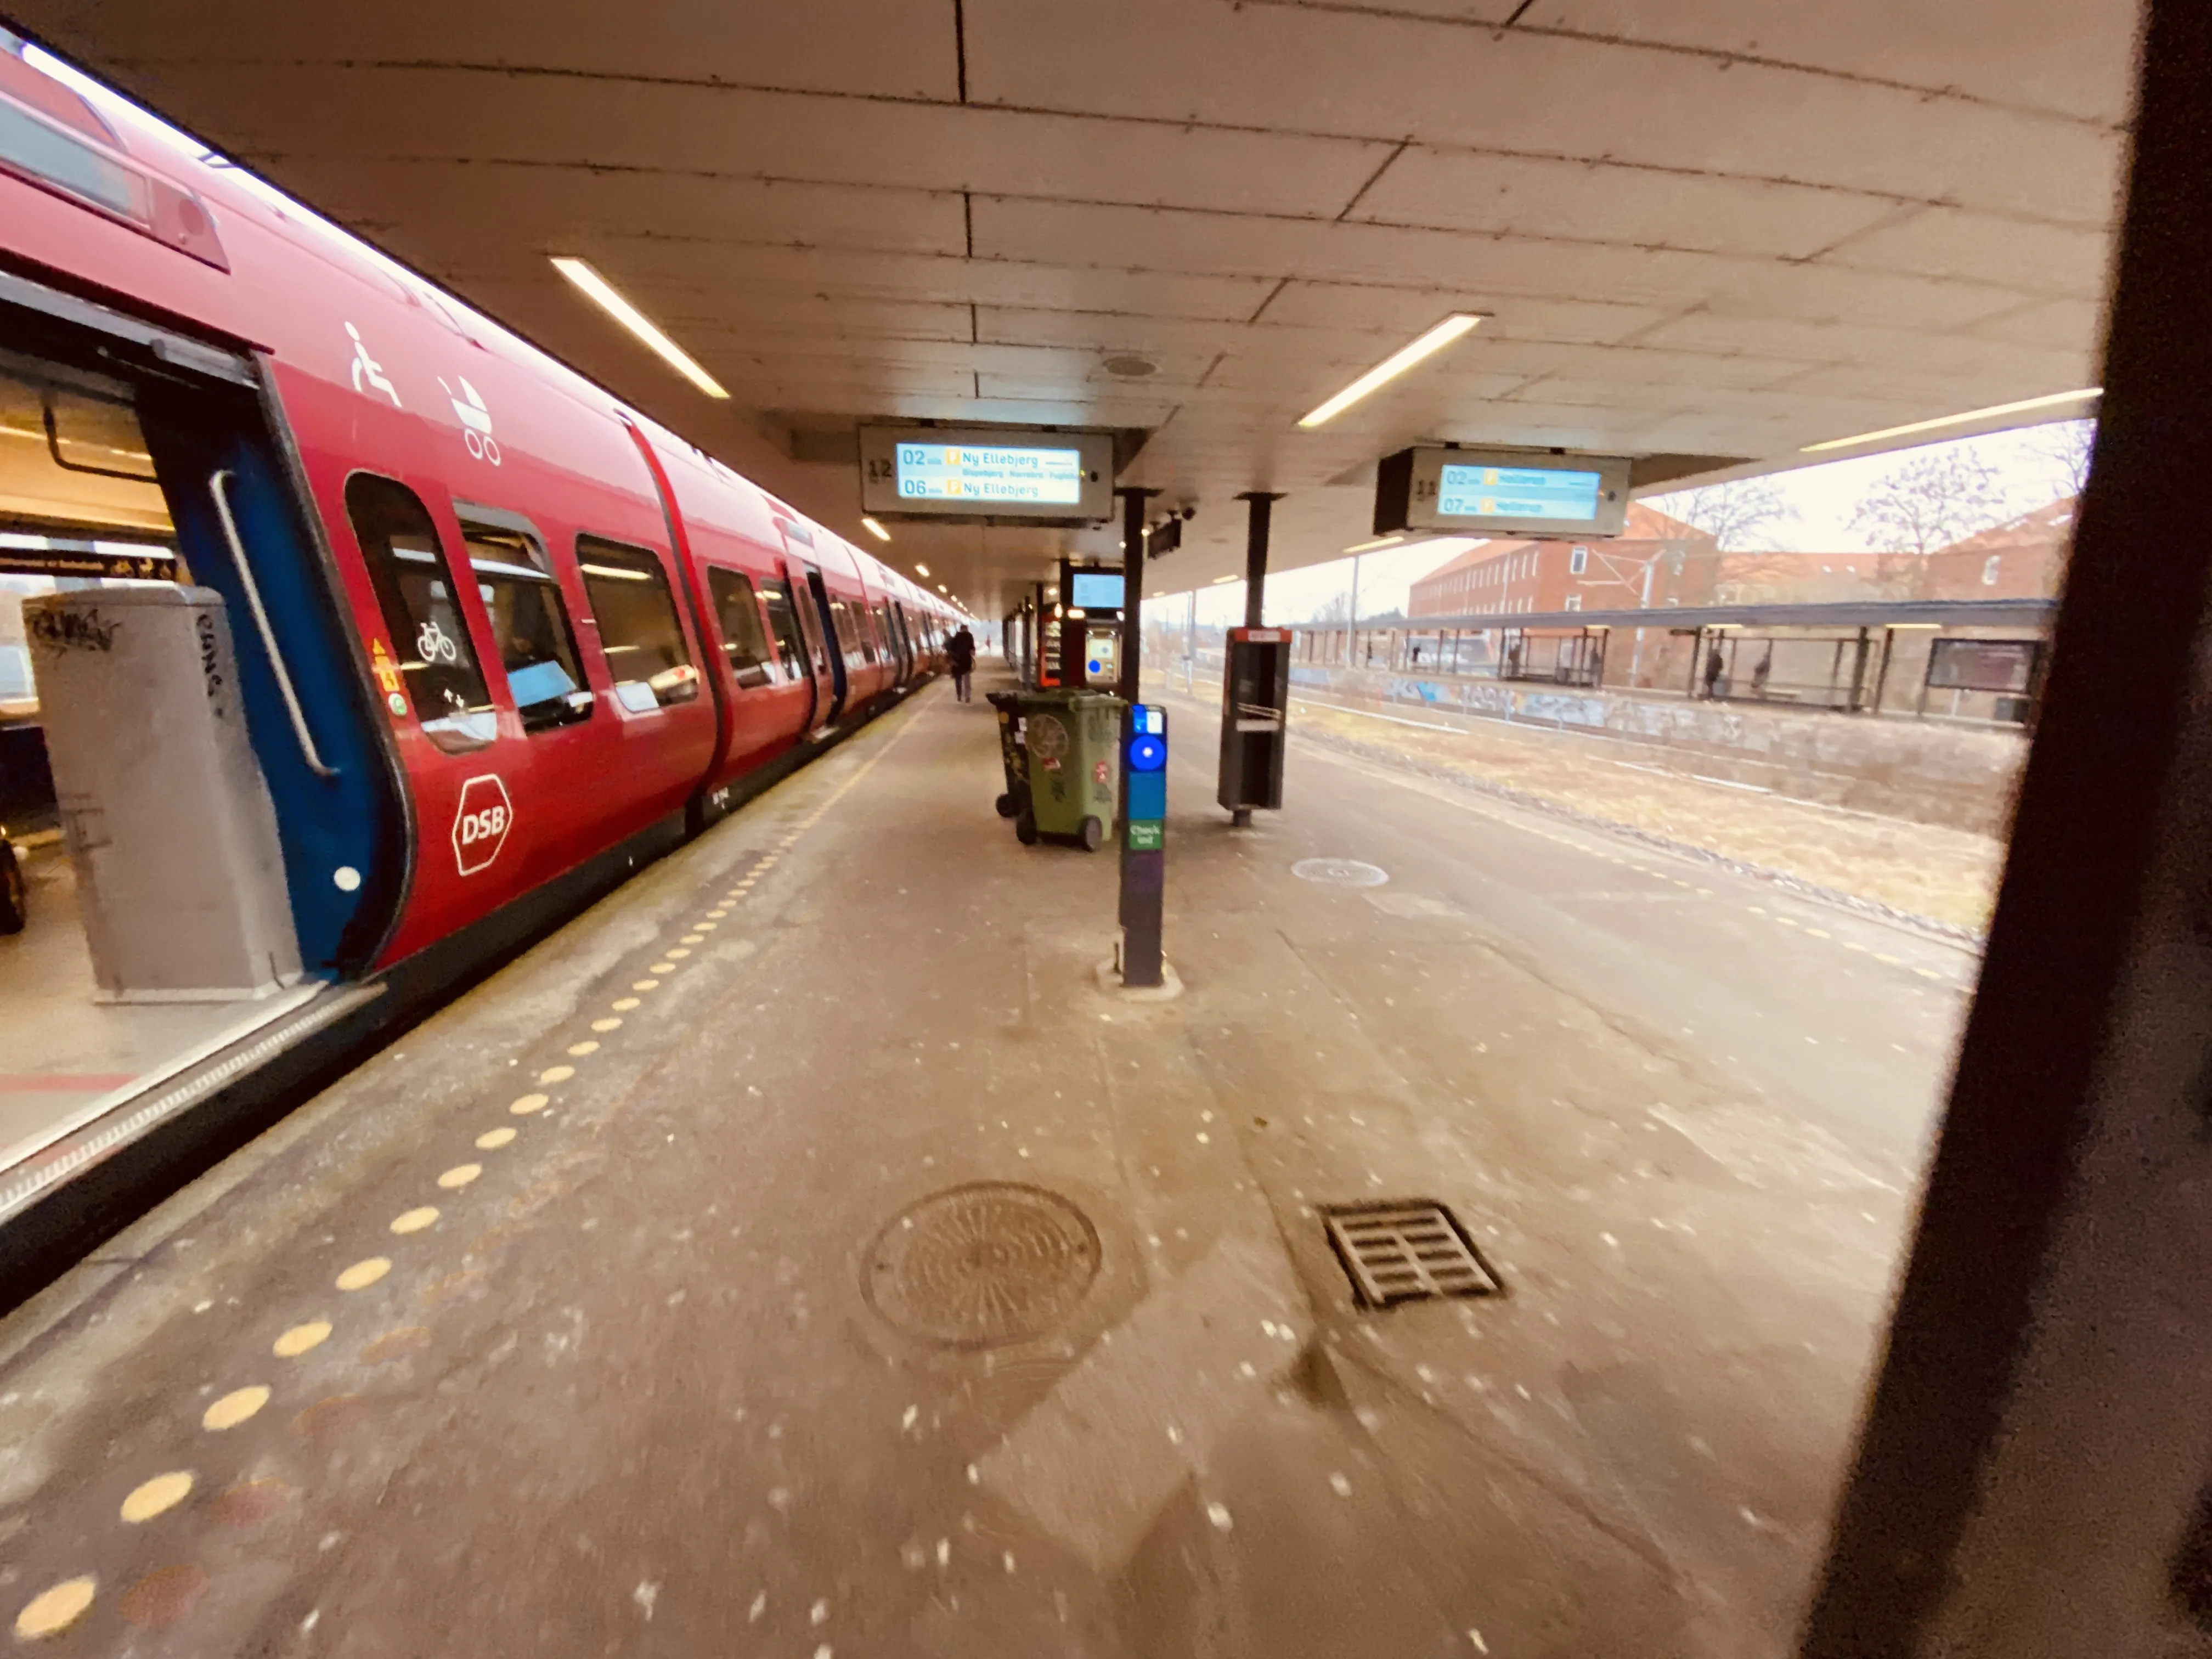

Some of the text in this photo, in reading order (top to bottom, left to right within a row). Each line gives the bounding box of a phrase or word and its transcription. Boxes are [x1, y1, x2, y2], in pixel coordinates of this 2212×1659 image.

[903, 449, 925, 465] 02
[963, 453, 979, 466] Ny
[983, 453, 1038, 468] Ellebjerg
[869, 459, 892, 477] 12
[905, 479, 926, 494] 06
[964, 483, 979, 495] Ny
[984, 483, 1039, 497] Ellebjerg
[1443, 498, 1464, 511] 07
[462, 805, 505, 845] DSB
